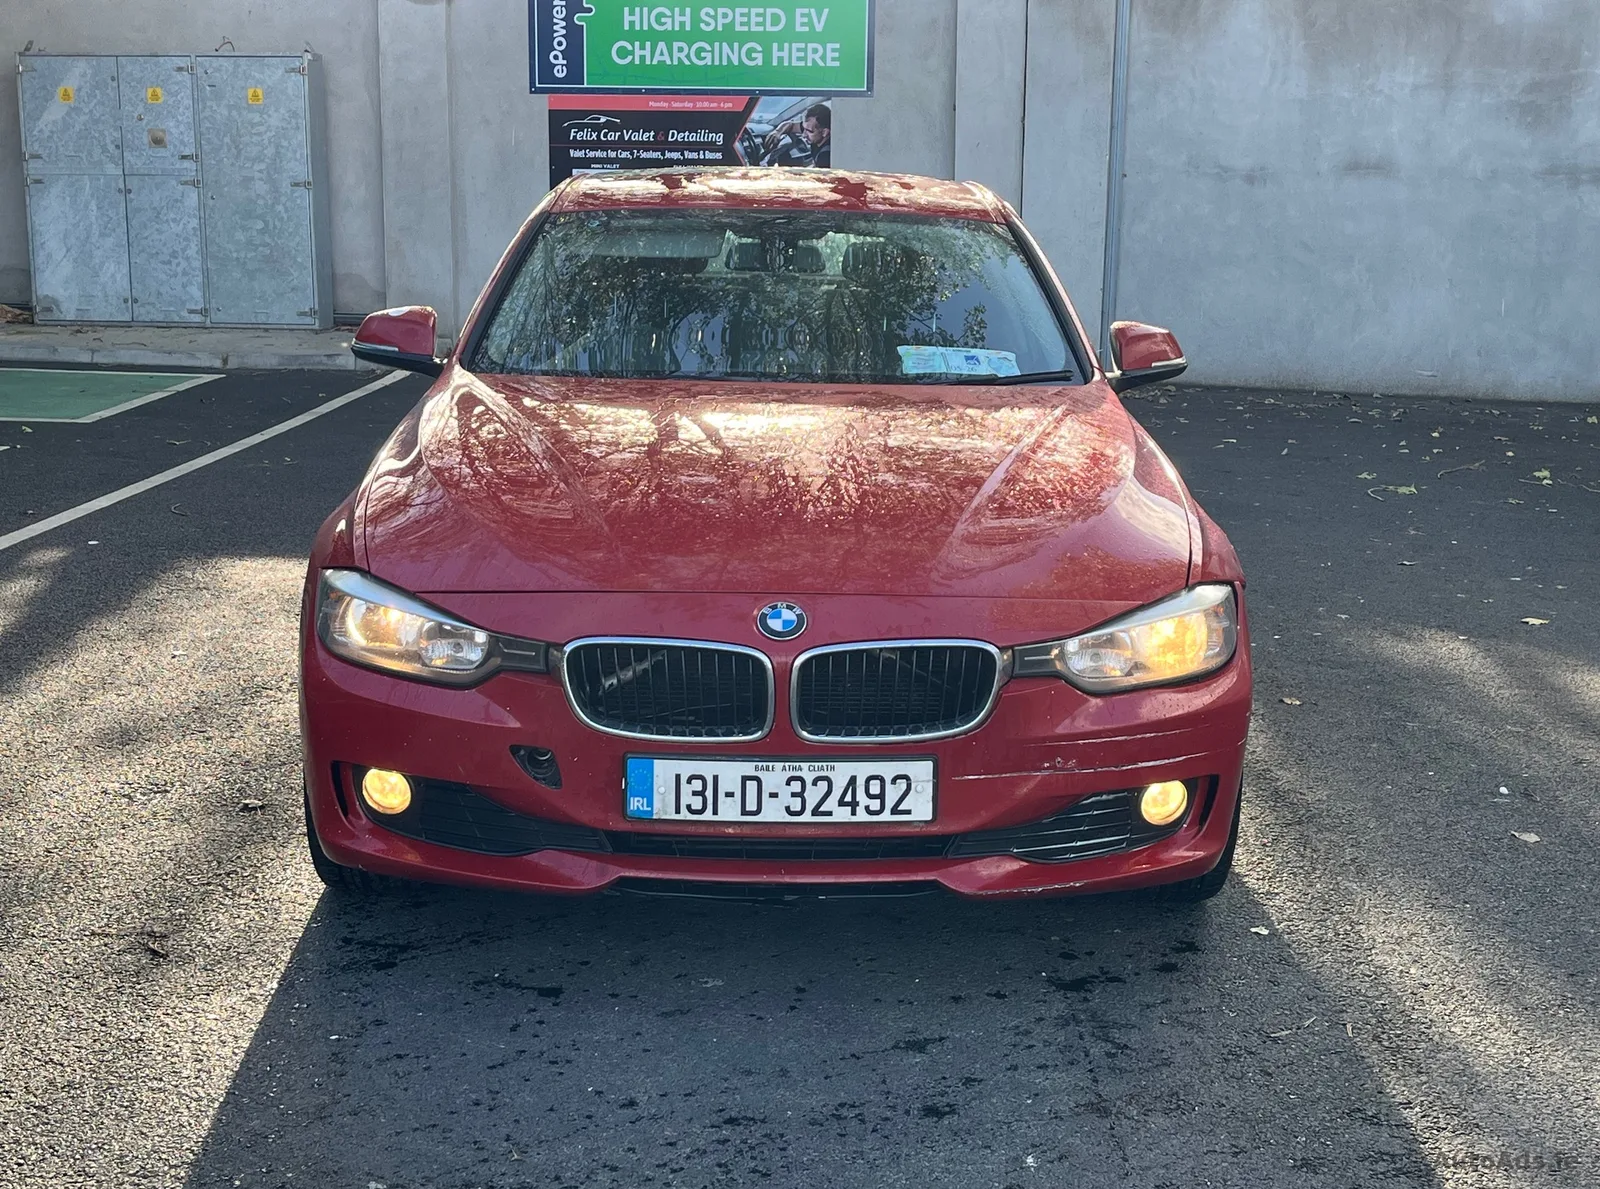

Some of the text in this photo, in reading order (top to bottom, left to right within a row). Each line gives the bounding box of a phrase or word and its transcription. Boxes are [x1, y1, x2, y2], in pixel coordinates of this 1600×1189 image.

[623, 7, 829, 32] HIGH SPEED EV
[549, 0, 568, 78] ePower
[611, 40, 841, 67] CHARGING HERE
[671, 101, 693, 109] Saturday
[569, 128, 724, 145] Felix Car Valet & Detailing
[569, 149, 723, 160] Valet Service for Cars, 7-Seaters, Jeeps, Vans & Buses
[754, 764, 776, 772] BAILE
[807, 764, 836, 773] CLIATH
[673, 773, 913, 817] 131-D-32492
[629, 796, 652, 812] IRL
